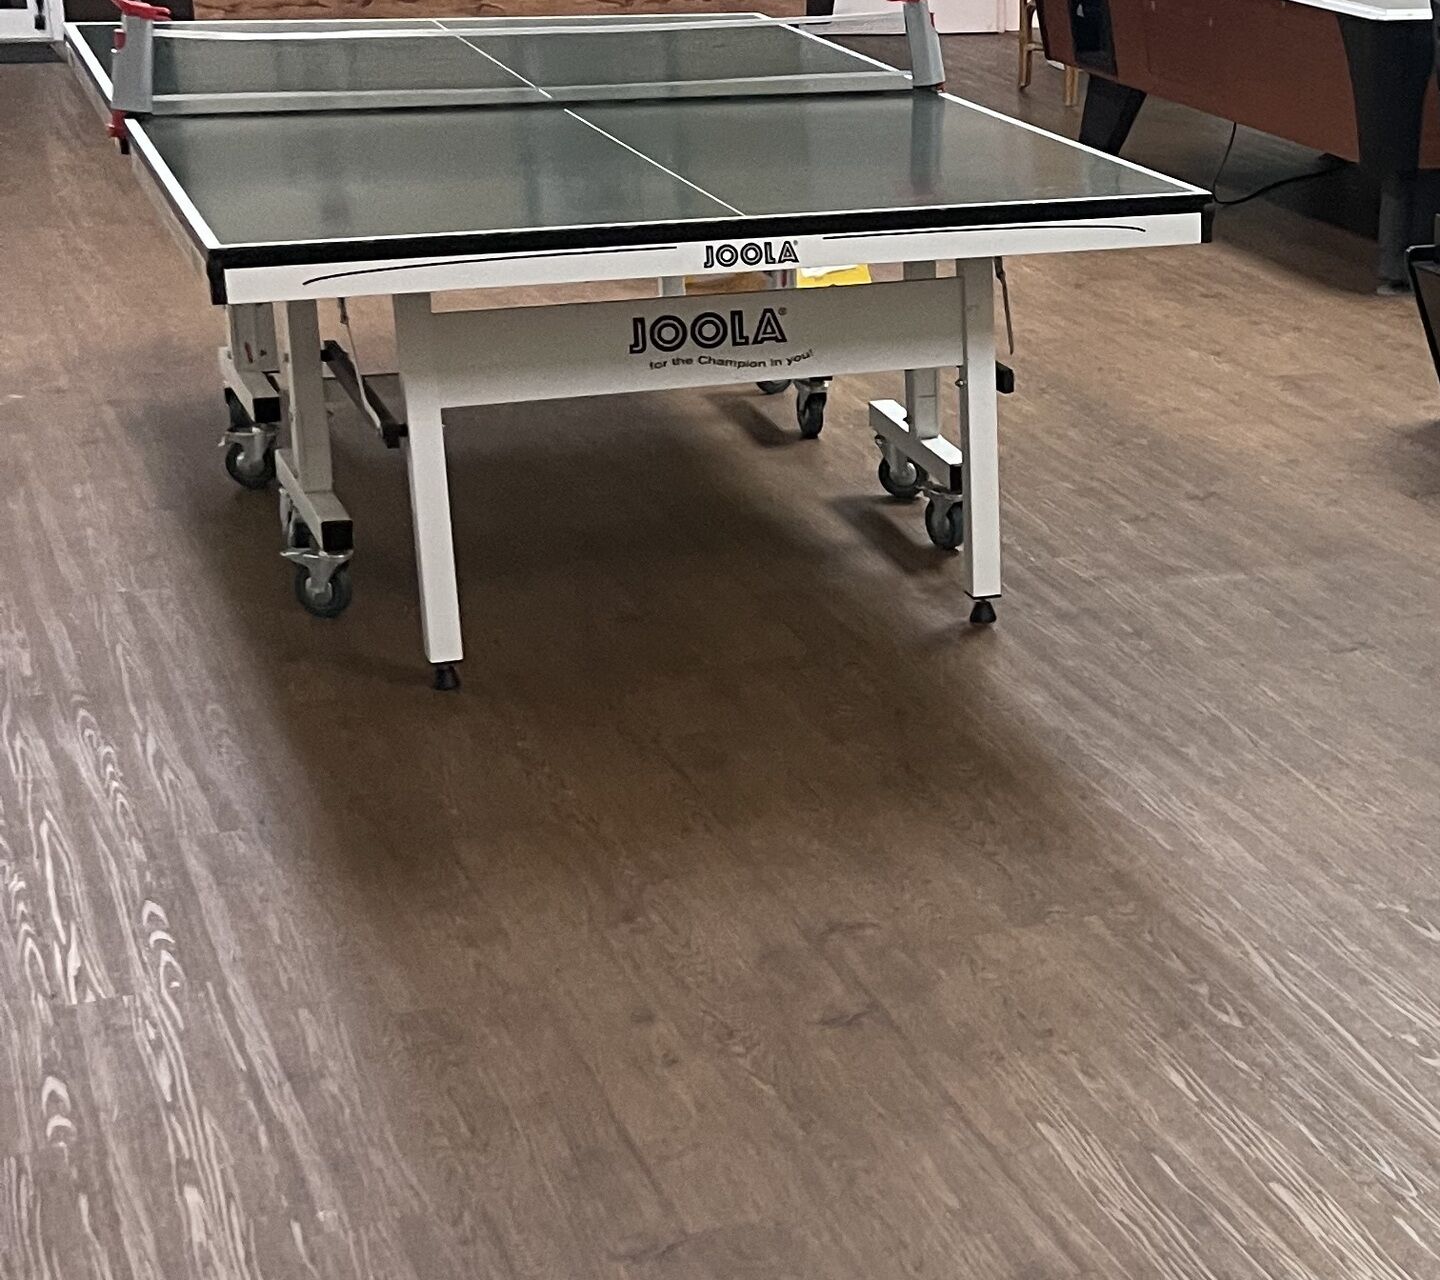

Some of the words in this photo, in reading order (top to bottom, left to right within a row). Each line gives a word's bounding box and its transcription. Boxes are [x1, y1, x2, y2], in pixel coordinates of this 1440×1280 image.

[650, 360, 668, 370] for
[672, 356, 694, 366] the
[697, 355, 767, 369] Champion
